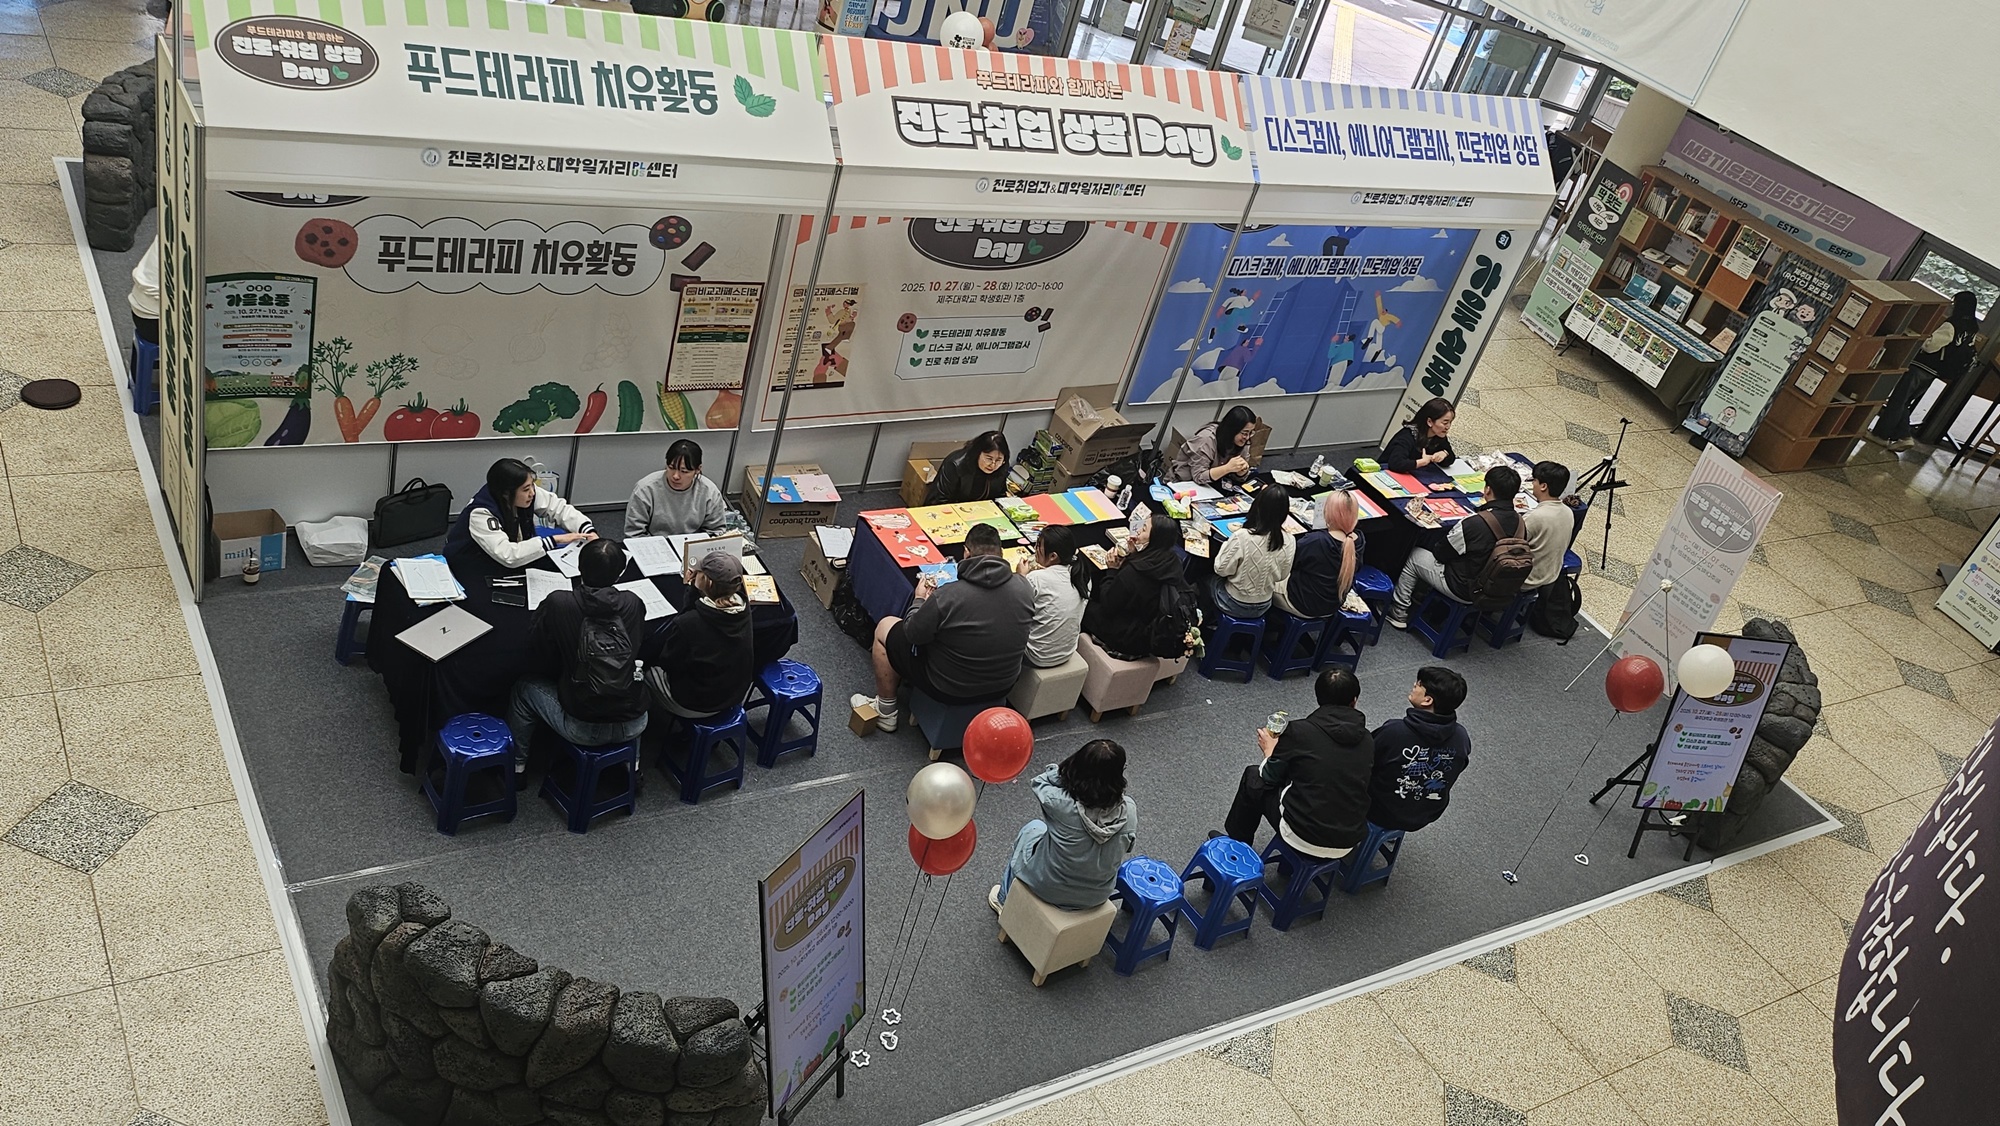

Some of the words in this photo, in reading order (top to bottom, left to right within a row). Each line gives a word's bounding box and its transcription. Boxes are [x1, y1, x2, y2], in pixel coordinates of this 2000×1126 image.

[246, 25, 306, 40] 푸드테라피와
[306, 30, 345, 44] 함께하는
[231, 35, 320, 61] 진로·취업
[323, 44, 363, 65] 상담
[280, 61, 331, 86] Day
[403, 42, 585, 106] 푸드테라피
[590, 60, 720, 116] 치유활동
[976, 69, 1065, 95] 푸드테라피와
[1067, 78, 1124, 100] 함께하는
[894, 98, 1058, 153] 진로·취업
[1060, 111, 1132, 155] 상담
[1133, 113, 1217, 166] Day
[1263, 116, 1348, 161] 디스크검사,
[1348, 122, 1456, 167] 에니어그램검사,
[1455, 130, 1512, 166] 진로취업
[1513, 135, 1540, 167] 상담
[1681, 139, 1731, 174] MBTI
[1724, 161, 1775, 196] 유형별
[1766, 182, 1822, 217] BEST
[1813, 203, 1856, 232] 직업
[1606, 192, 1623, 211] 맞는
[1776, 220, 1800, 235] ESTP
[378, 235, 524, 275] 푸드테라피
[531, 238, 639, 277] 치유활동
[973, 238, 1025, 263] Day
[1828, 244, 1854, 259] ESFP
[1228, 256, 1262, 279] 디스크
[1263, 257, 1285, 281] 검사,
[1286, 257, 1361, 281] 에니어그램검사,
[1361, 258, 1400, 276] 진로취업
[1399, 256, 1423, 275] 상담
[900, 283, 926, 292] 2025.
[929, 281, 943, 291] 10.
[1014, 280, 1064, 291] 12:00~16:00
[1782, 270, 1809, 288] (ROTC)
[225, 293, 291, 308] 가을소풍
[698, 286, 759, 297] 비교과페스티벌
[936, 294, 977, 304] 제주대학교
[979, 294, 1012, 303] 학생회관
[1013, 293, 1026, 303] 1층
[931, 329, 973, 339] 푸드테라피
[974, 327, 1008, 337] 치유활동
[1421, 254, 1504, 398] 가을소풍
[928, 343, 953, 352] 디스크
[975, 340, 1031, 351] 에니어그램검사
[925, 357, 942, 366] 진로
[943, 356, 961, 366] 취업
[961, 355, 979, 365] 상담
[769, 517, 803, 526] coupang
[804, 515, 829, 525] travel
